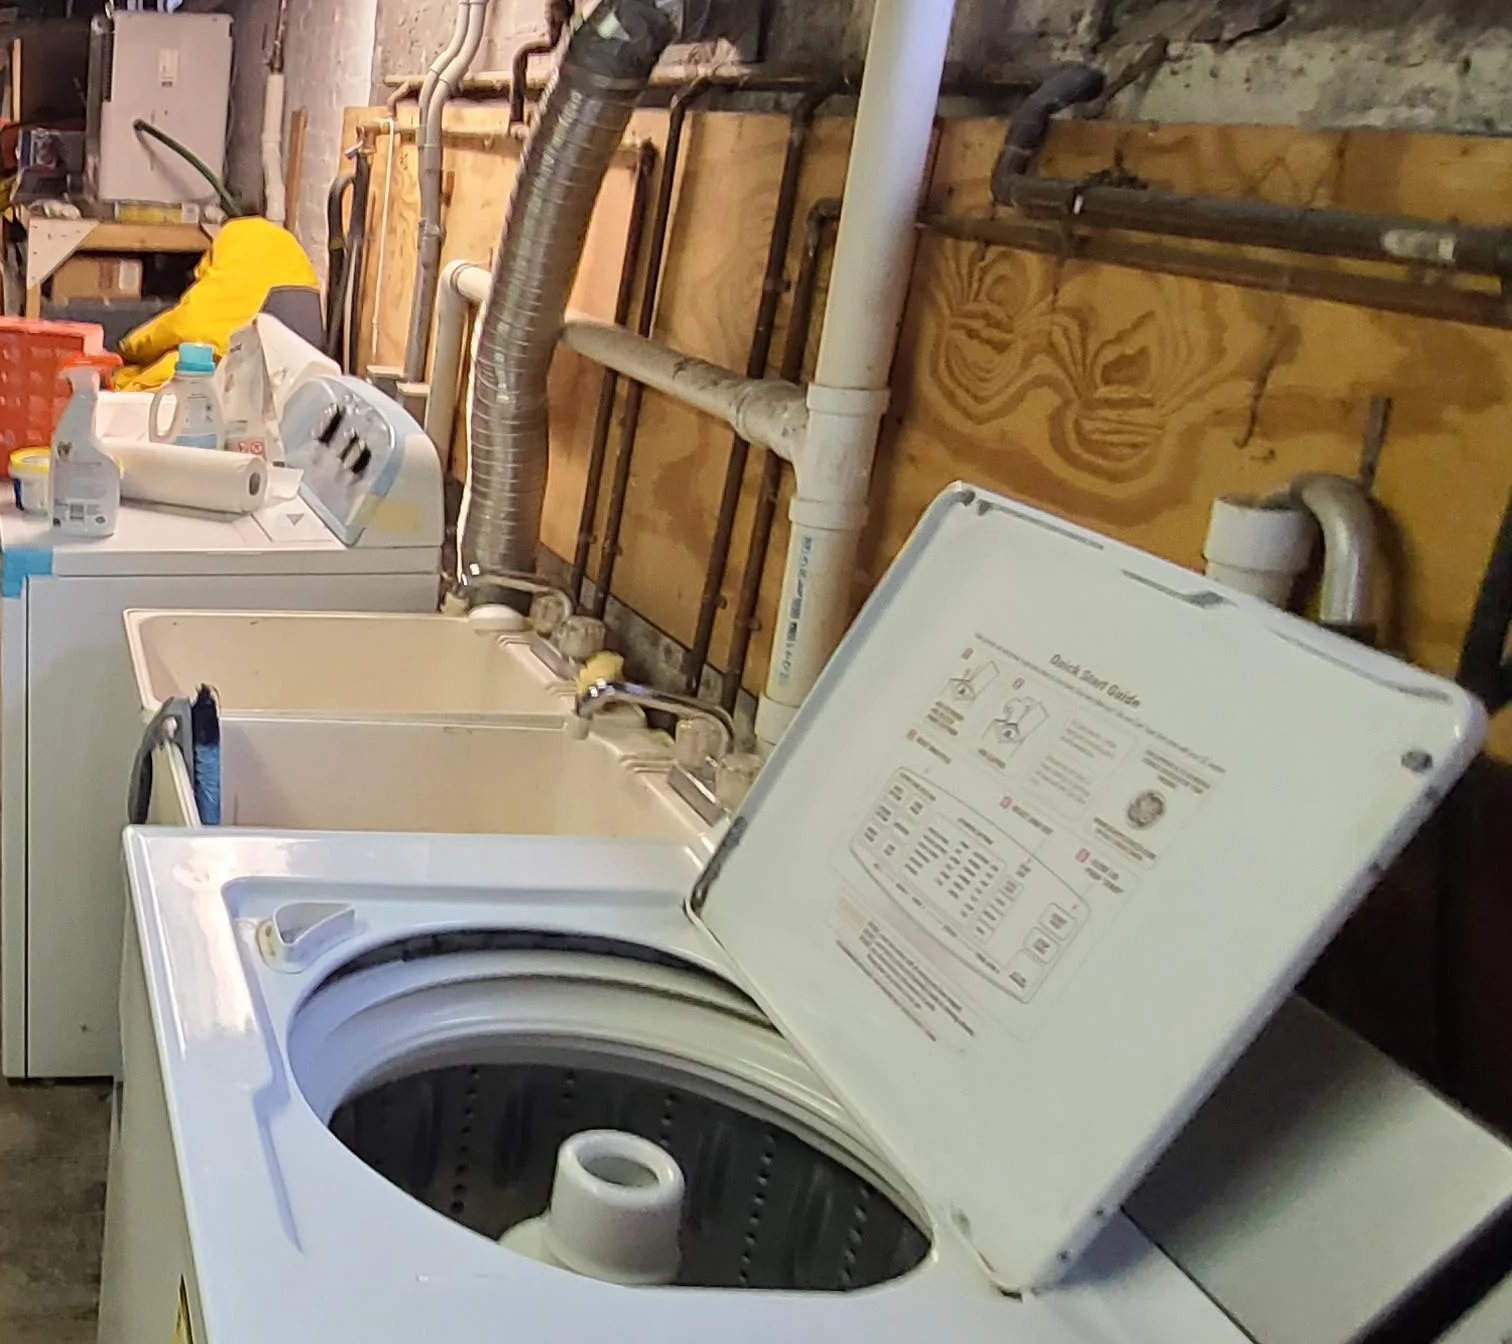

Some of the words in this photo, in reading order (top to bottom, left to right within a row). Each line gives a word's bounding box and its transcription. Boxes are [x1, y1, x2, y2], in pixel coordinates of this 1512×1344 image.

[1049, 653, 1080, 676] Quick
[1079, 669, 1108, 691] Start
[1106, 684, 1141, 709] Guide
